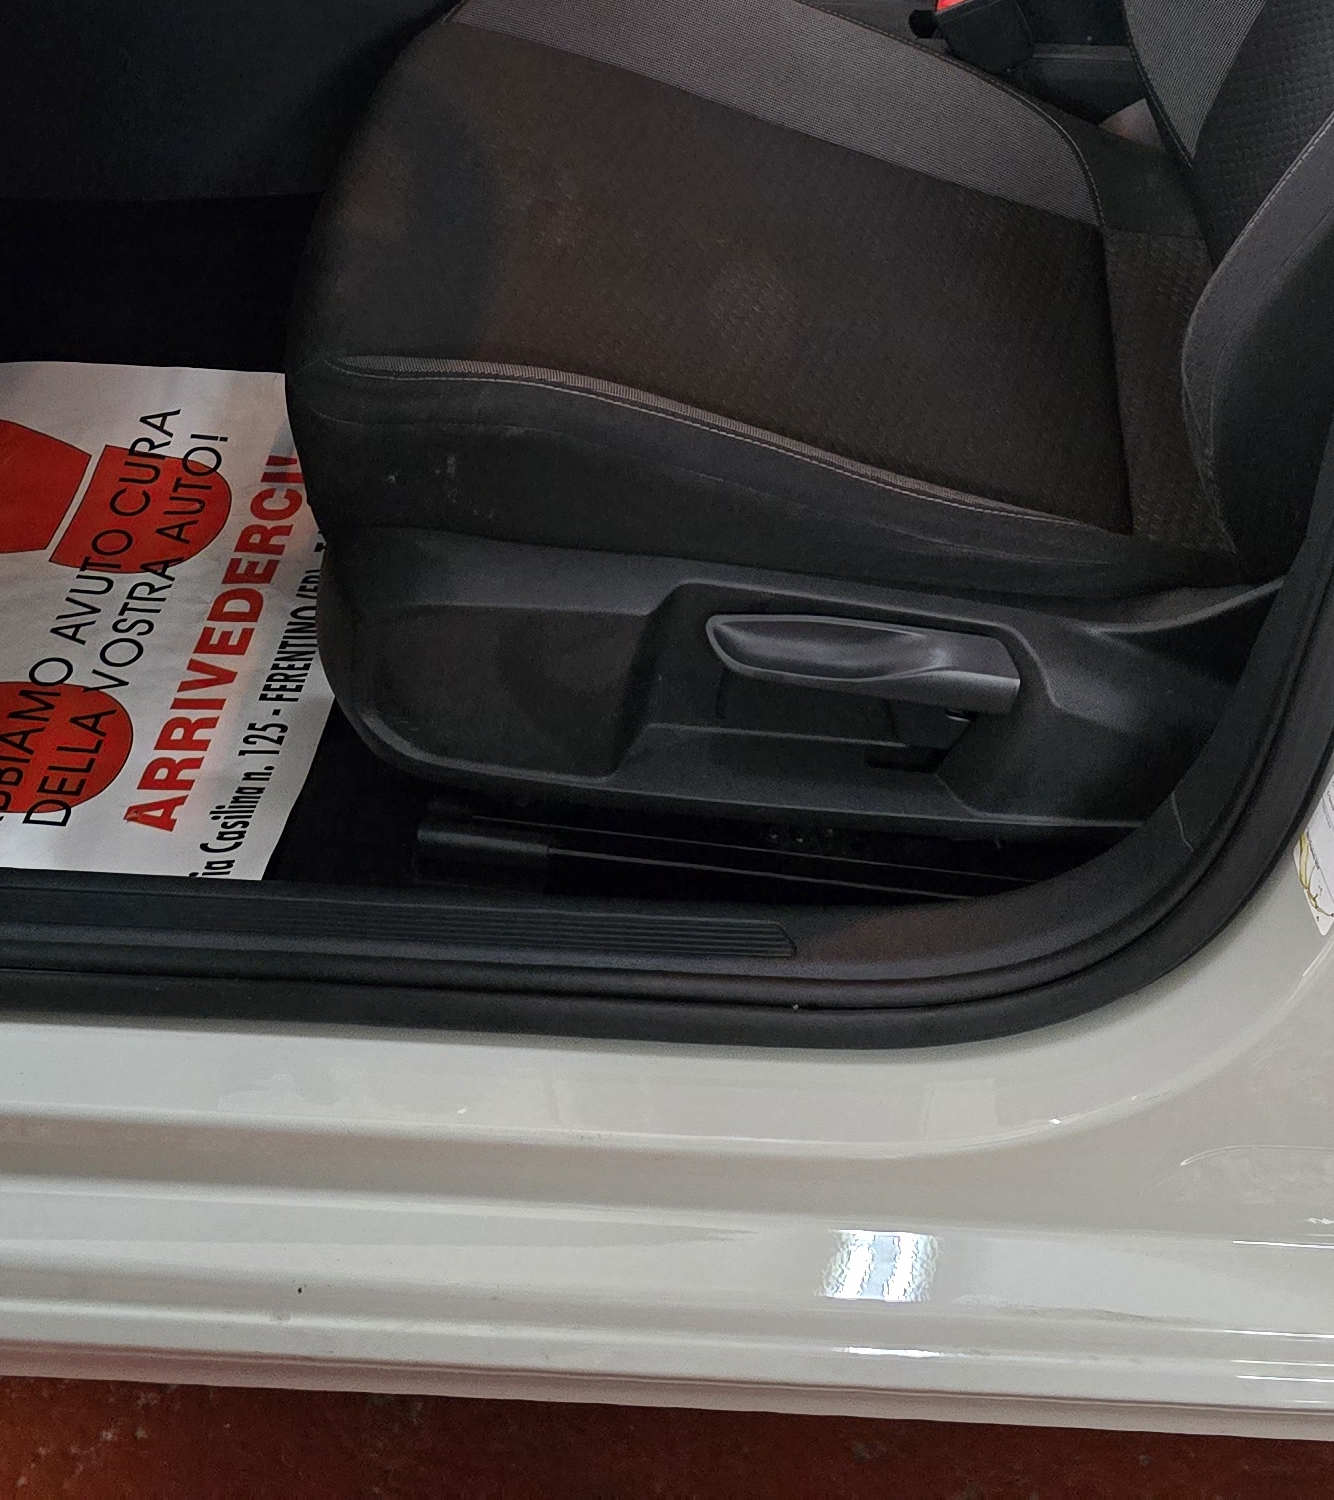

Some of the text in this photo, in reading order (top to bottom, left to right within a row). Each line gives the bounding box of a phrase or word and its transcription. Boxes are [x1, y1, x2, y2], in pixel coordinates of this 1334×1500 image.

[50, 528, 134, 646] AVUTO
[110, 407, 182, 518] CURA
[22, 432, 229, 827] DELLA VOSTRA AUTO!
[258, 605, 318, 703] FERENTINO
[238, 721, 289, 758] 125
[242, 763, 275, 787] n.
[199, 785, 264, 854] Casilina
